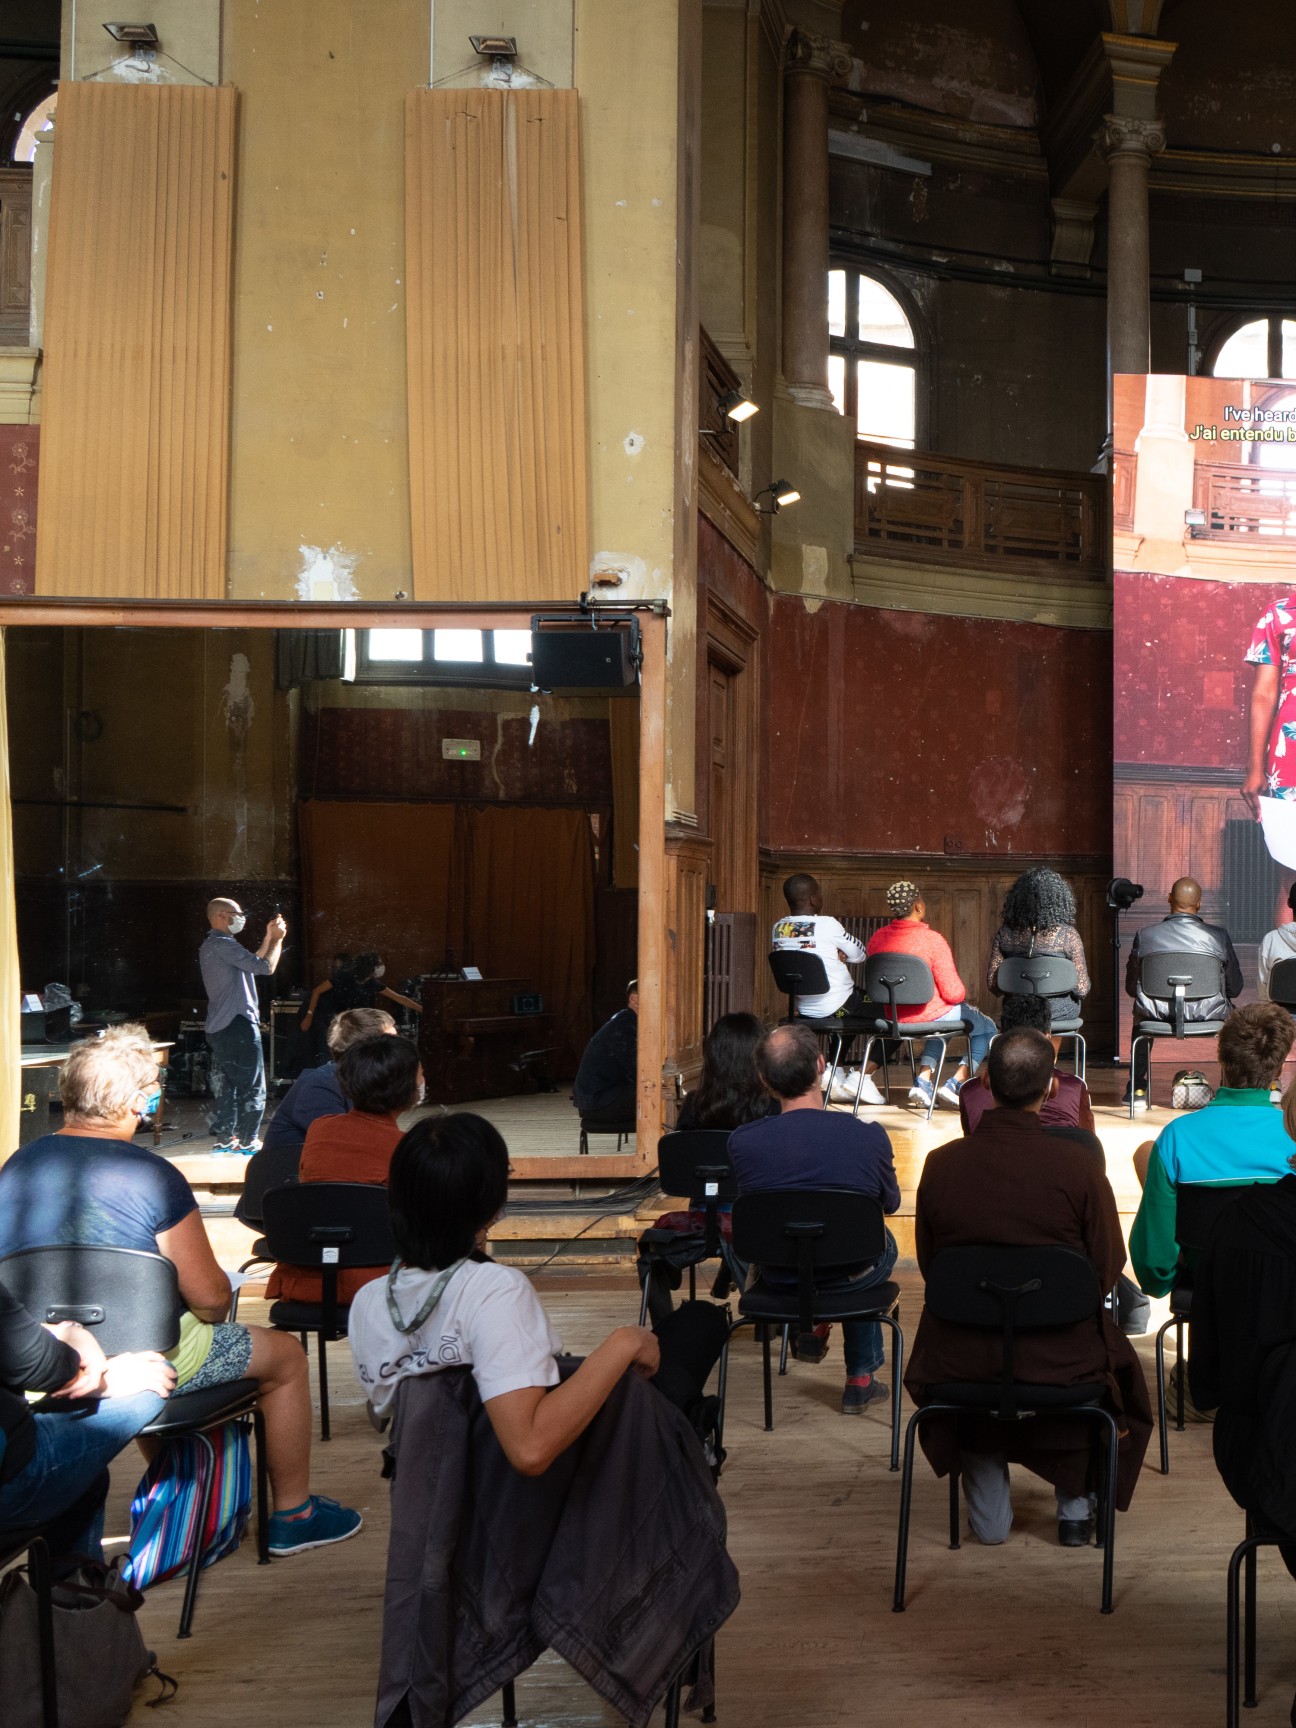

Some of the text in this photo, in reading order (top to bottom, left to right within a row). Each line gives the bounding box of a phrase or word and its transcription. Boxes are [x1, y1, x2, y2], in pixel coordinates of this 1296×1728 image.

[1224, 406, 1252, 421] I've
[1189, 425, 1217, 440] J'ai
[1220, 427, 1284, 442] entendu
